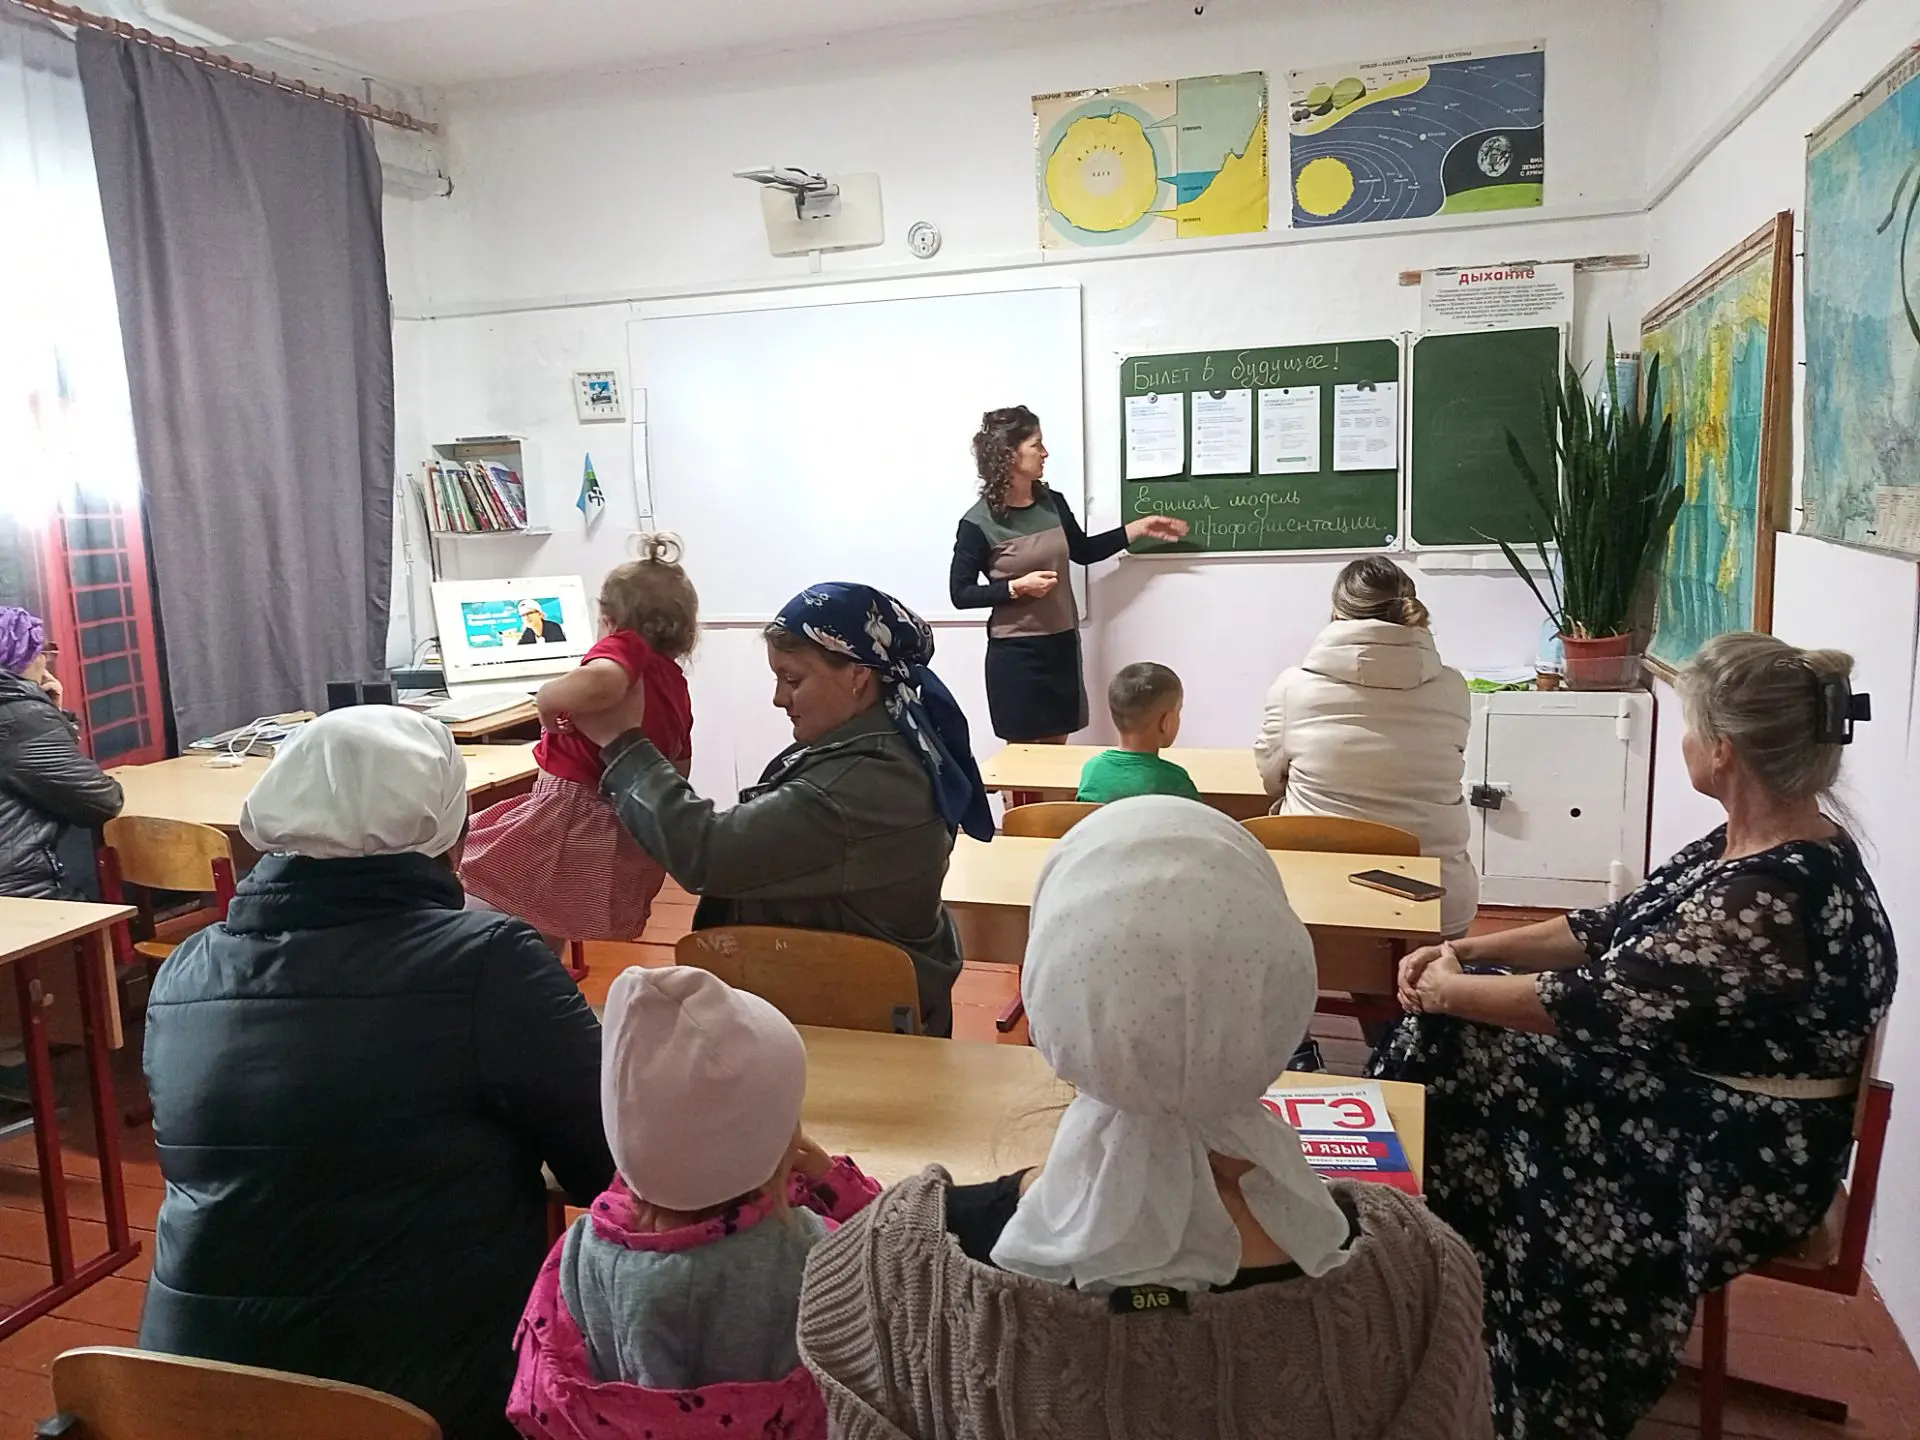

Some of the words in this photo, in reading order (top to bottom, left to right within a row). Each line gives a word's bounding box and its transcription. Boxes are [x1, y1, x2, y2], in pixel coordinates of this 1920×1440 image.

[1228, 488, 1301, 519] модель
[1319, 1143, 1369, 1155] ЯЗЫК
[1132, 1292, 1170, 1309] eve
